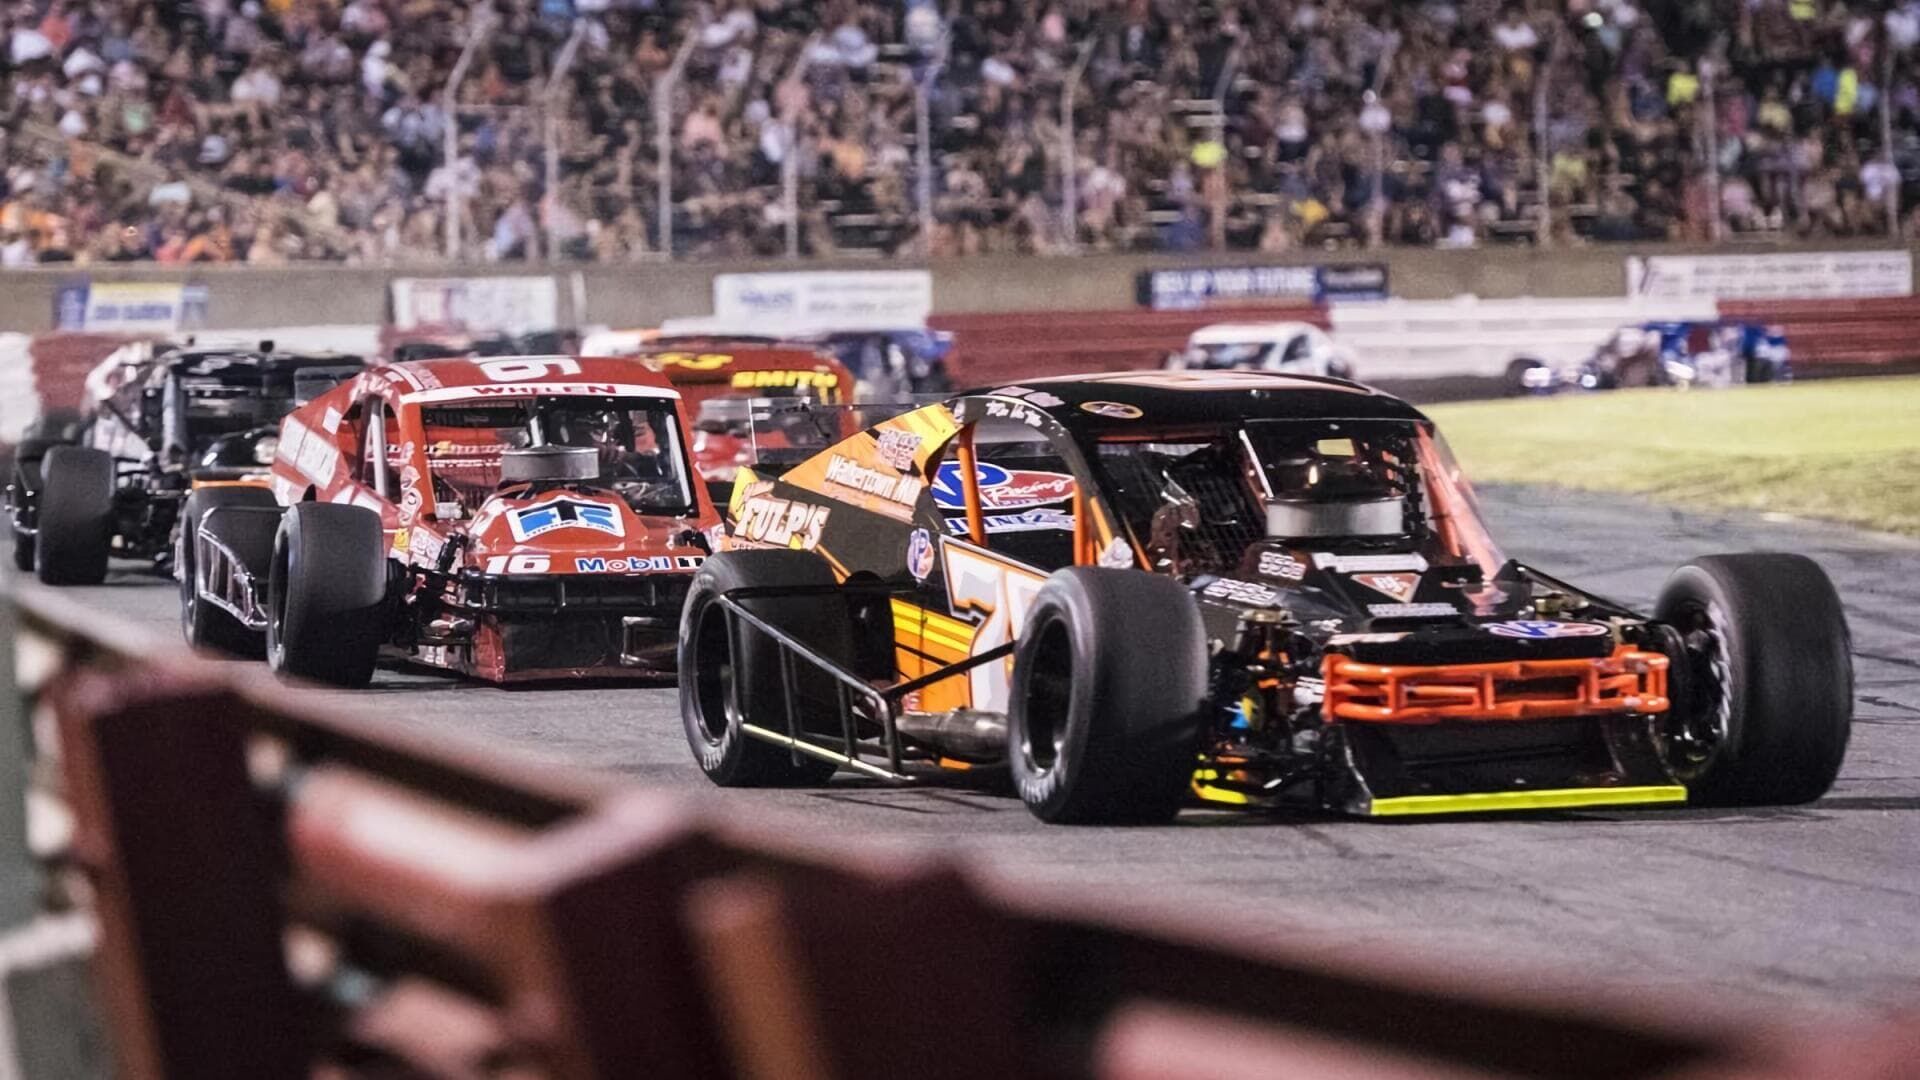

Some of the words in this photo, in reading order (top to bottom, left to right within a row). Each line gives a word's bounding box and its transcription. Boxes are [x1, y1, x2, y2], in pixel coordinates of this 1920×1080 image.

[732, 370, 837, 388] SMITH
[734, 498, 831, 551] FULP'S
[486, 554, 550, 574] 16
[575, 556, 669, 573] Mobil
